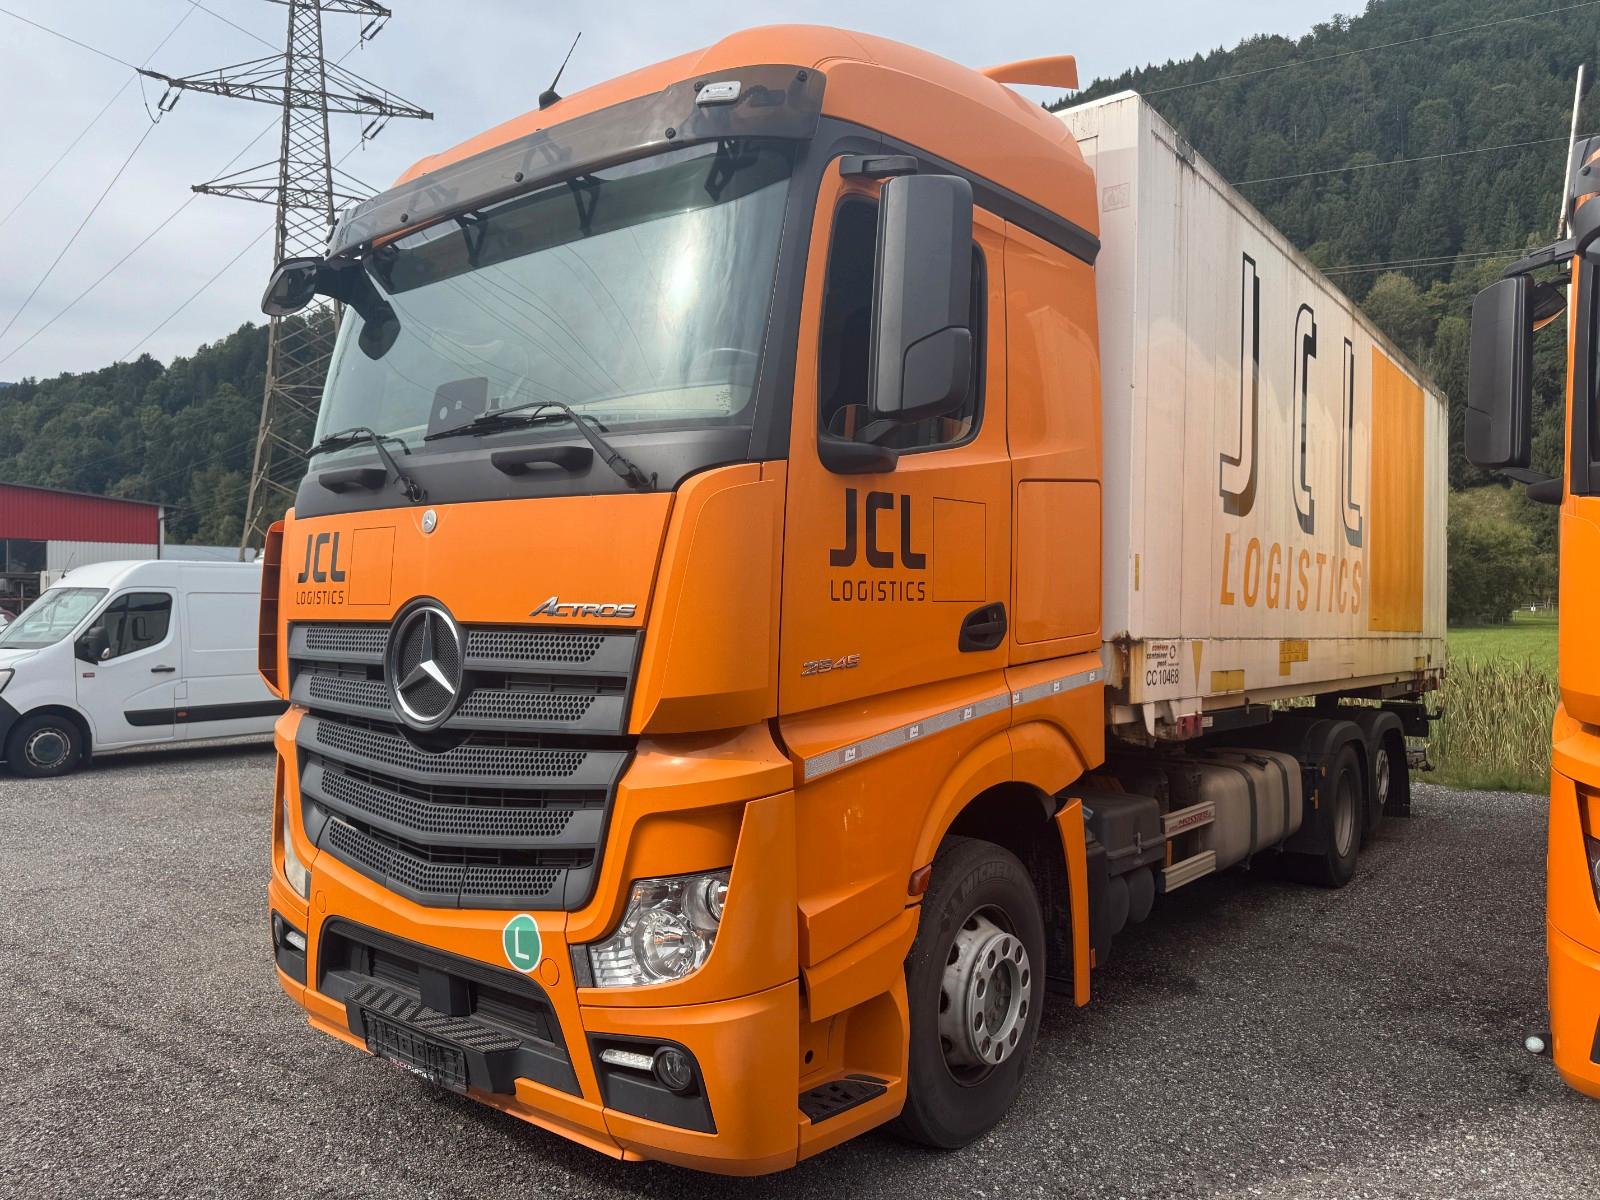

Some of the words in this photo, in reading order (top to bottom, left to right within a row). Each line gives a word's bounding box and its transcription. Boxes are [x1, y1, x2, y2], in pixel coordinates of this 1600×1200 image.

[1220, 251, 1362, 548] JCL
[830, 488, 926, 569] JCL
[298, 531, 346, 584] JCL
[1220, 532, 1363, 615] LOGISTICS
[296, 590, 345, 606] LOGISTICS
[831, 580, 926, 601] LOGISTICS
[801, 653, 860, 676] 2545
[961, 862, 1016, 899] MICHELI
[515, 926, 530, 961] L
